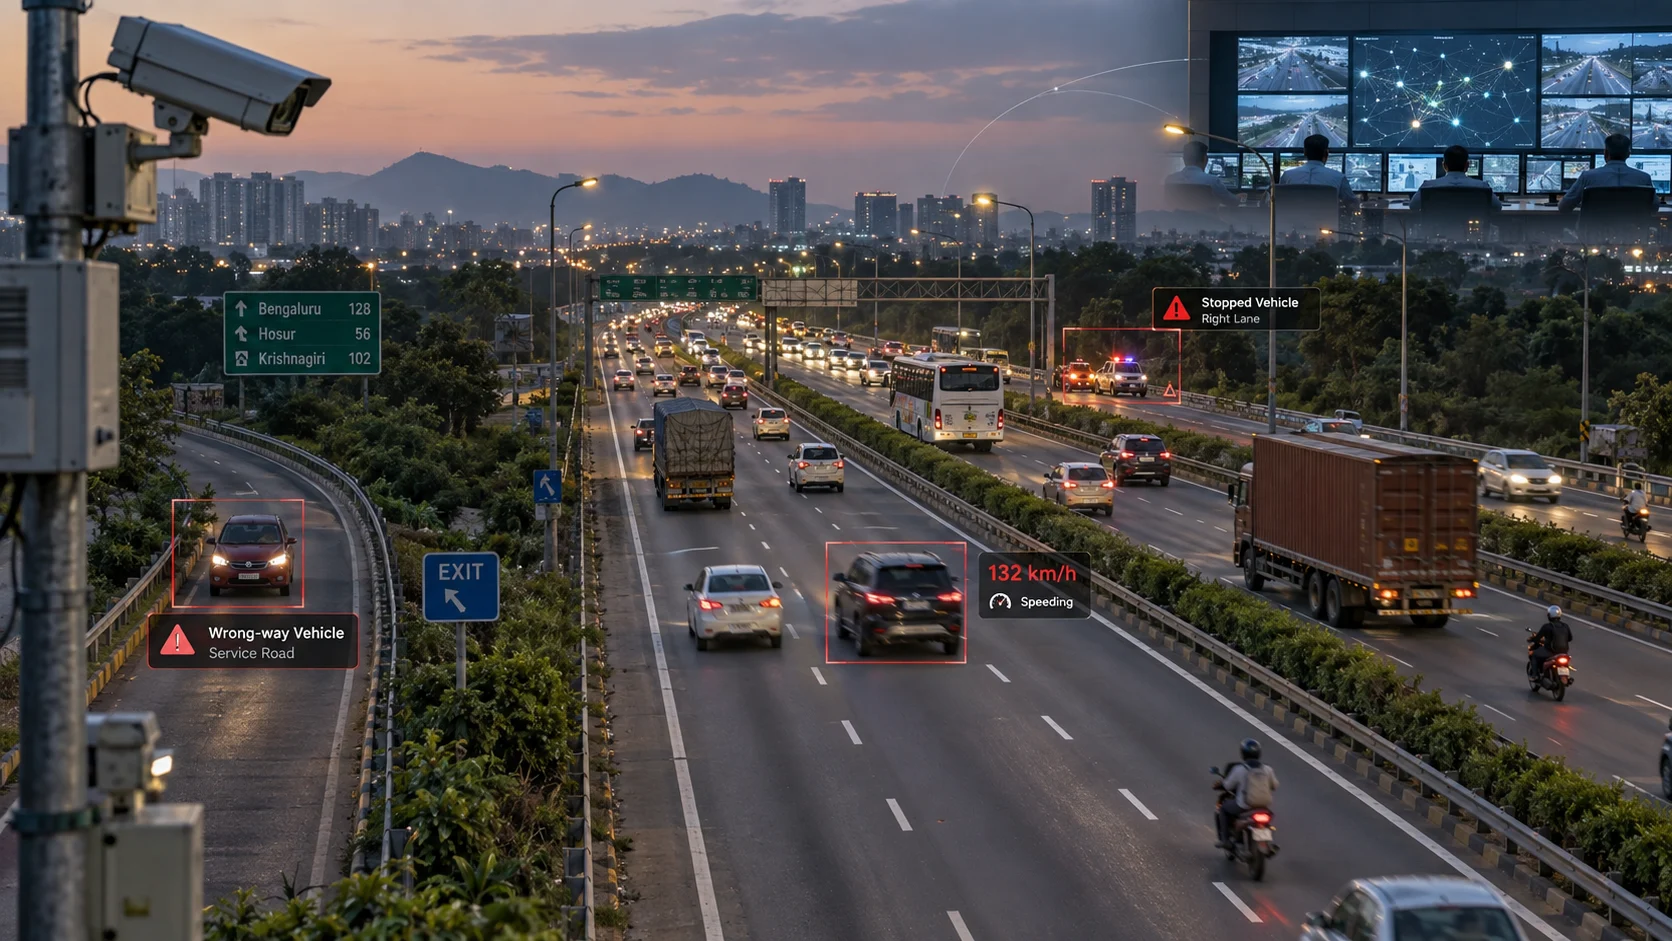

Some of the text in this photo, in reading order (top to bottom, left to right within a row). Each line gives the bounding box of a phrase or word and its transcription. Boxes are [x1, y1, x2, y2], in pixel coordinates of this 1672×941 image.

[258, 301, 371, 318] Bengaluru 128
[258, 326, 371, 341] Hosur 56
[258, 351, 371, 368] Krishnagiri 102
[438, 562, 484, 581] EXIT
